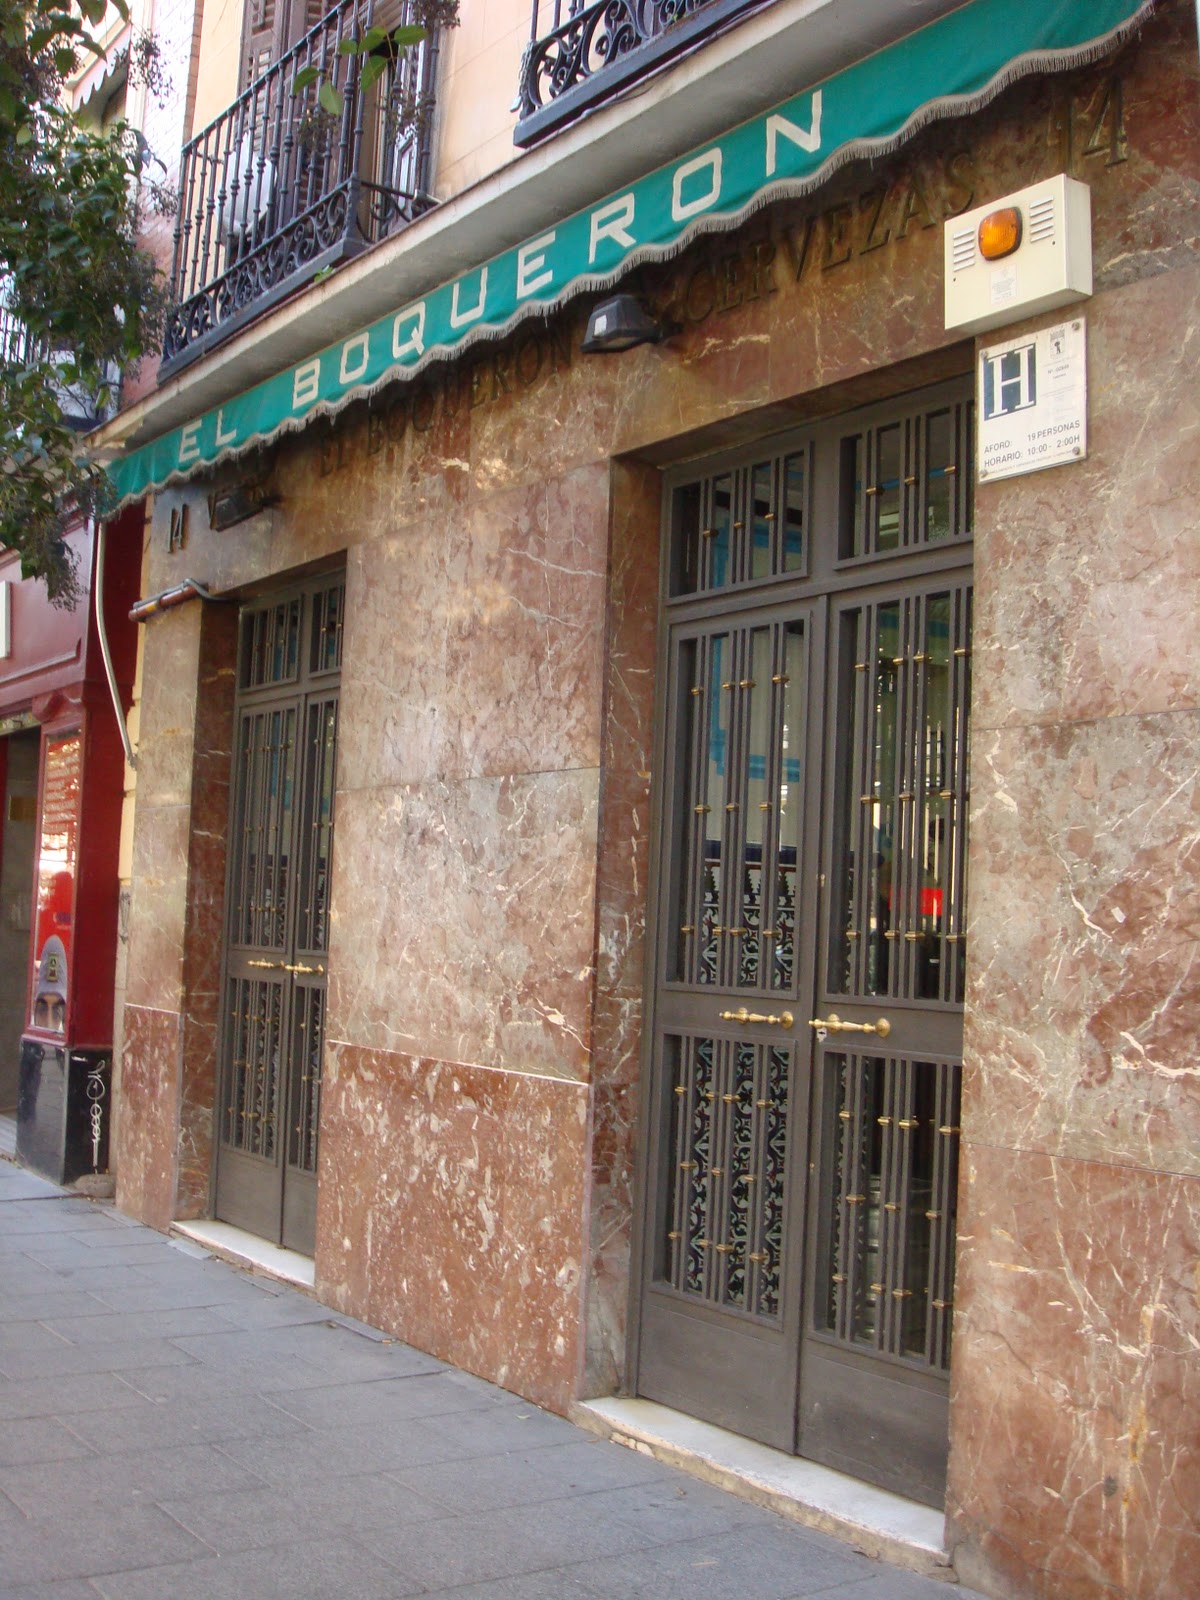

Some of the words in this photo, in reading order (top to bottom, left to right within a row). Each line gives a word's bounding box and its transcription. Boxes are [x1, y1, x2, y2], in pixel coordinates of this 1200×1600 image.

[686, 150, 976, 322] CERVEZAS
[178, 409, 237, 463] EL
[292, 89, 823, 410] BOQUERON
[988, 344, 1035, 418] H
[984, 440, 1012, 454] AFORO:
[1027, 431, 1037, 442] 19
[1037, 420, 1081, 440] PERSONAS
[984, 451, 1023, 468] HORARIO:
[1027, 443, 1048, 456] 10:00
[1057, 435, 1081, 448] 2:00H
